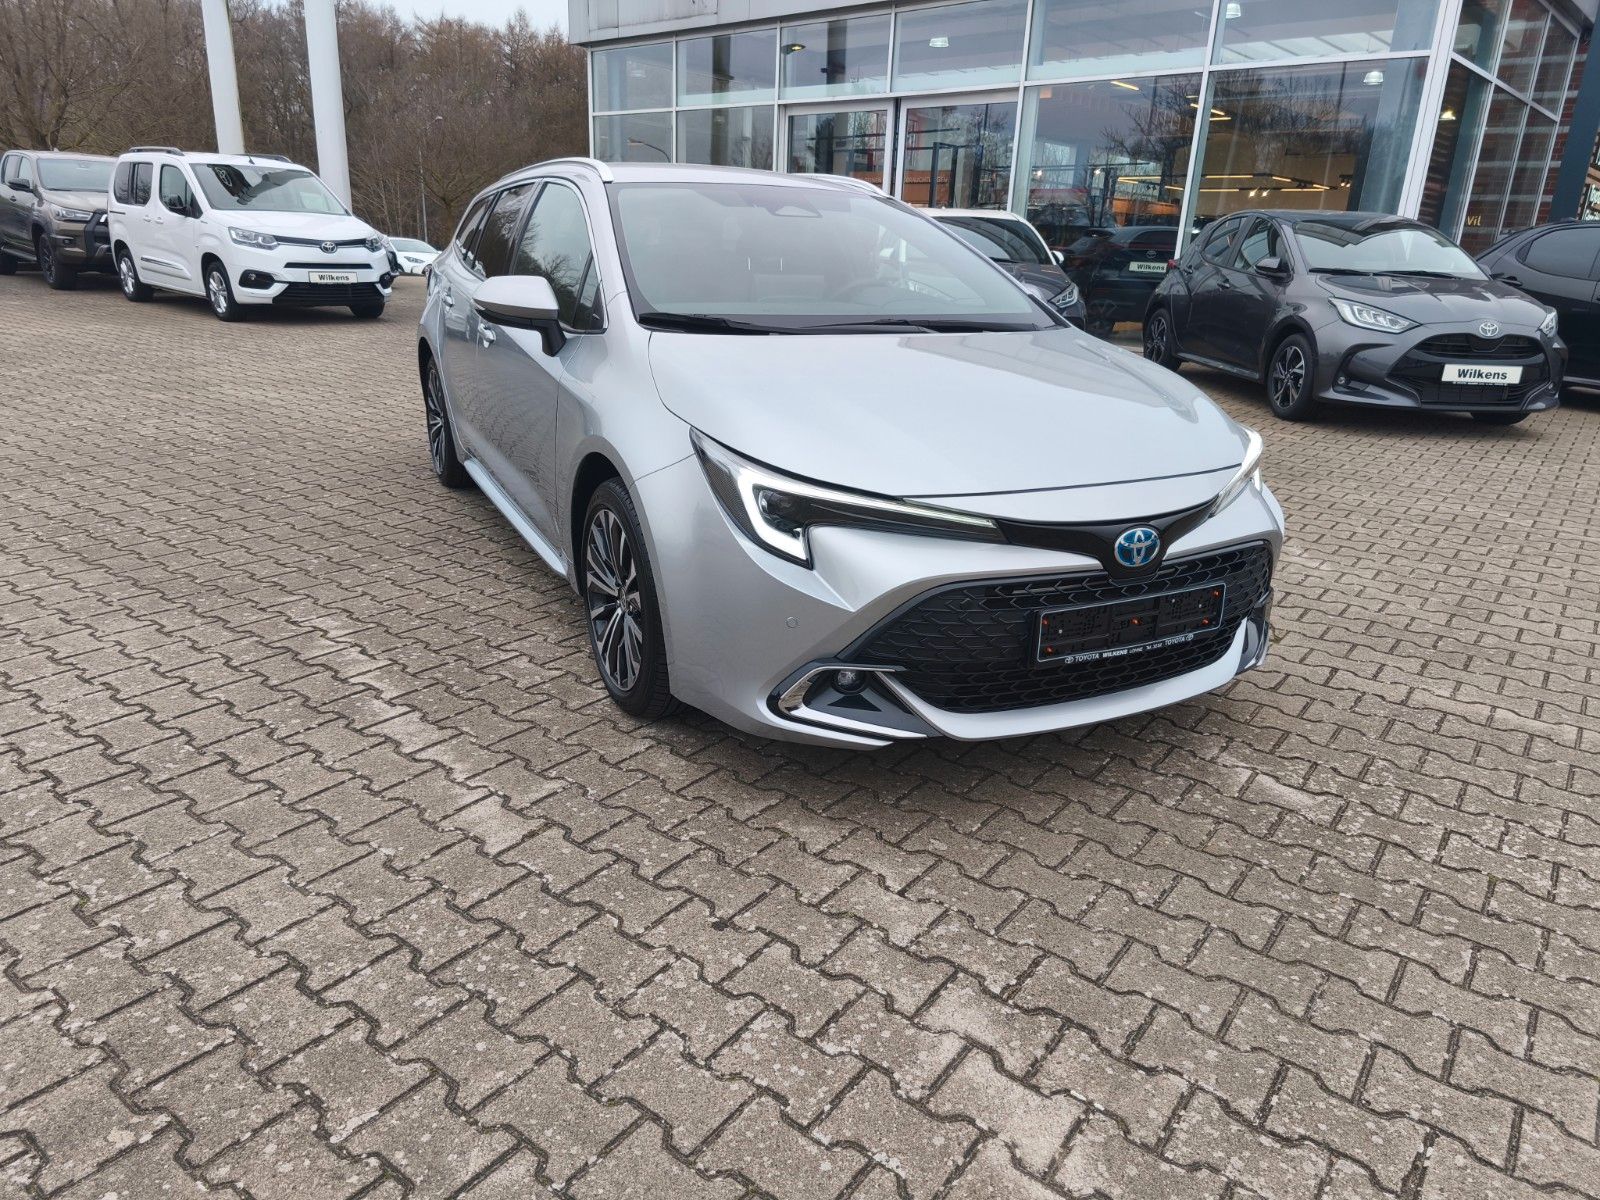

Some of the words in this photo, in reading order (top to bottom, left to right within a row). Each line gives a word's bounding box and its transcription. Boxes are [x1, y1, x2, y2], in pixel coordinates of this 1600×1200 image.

[1457, 368, 1508, 380] Wilkens
[1075, 653, 1100, 662] TOYOTA
[1102, 649, 1128, 658] WILKENS
[1165, 636, 1186, 645] TOYOTA
